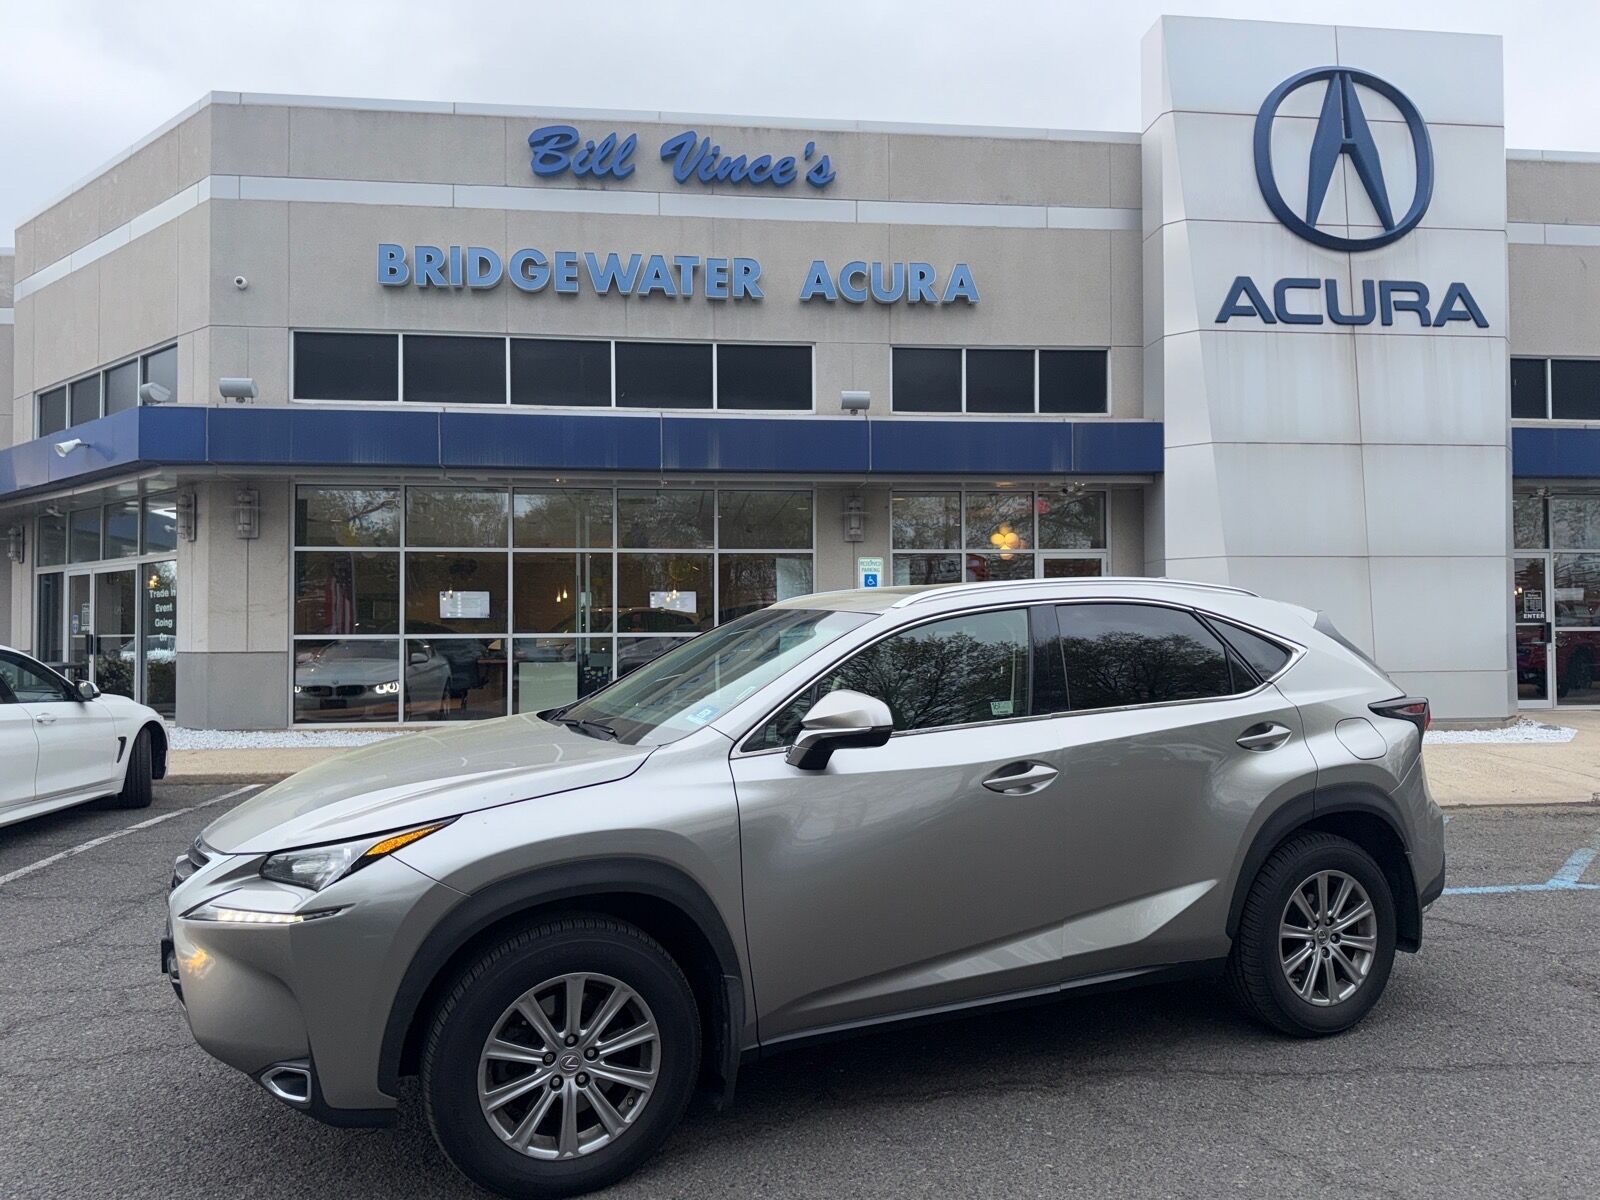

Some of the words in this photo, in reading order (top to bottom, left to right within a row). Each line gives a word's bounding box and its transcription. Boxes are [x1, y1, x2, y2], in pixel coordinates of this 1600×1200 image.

[528, 125, 637, 179] Bill
[660, 130, 836, 187] Vince's
[376, 243, 765, 301] BRIDGEWATER
[800, 260, 981, 305] ACURA
[1215, 275, 1489, 328] ACURA
[149, 589, 169, 598] Trade
[155, 603, 173, 612] Event
[154, 618, 173, 628] Going
